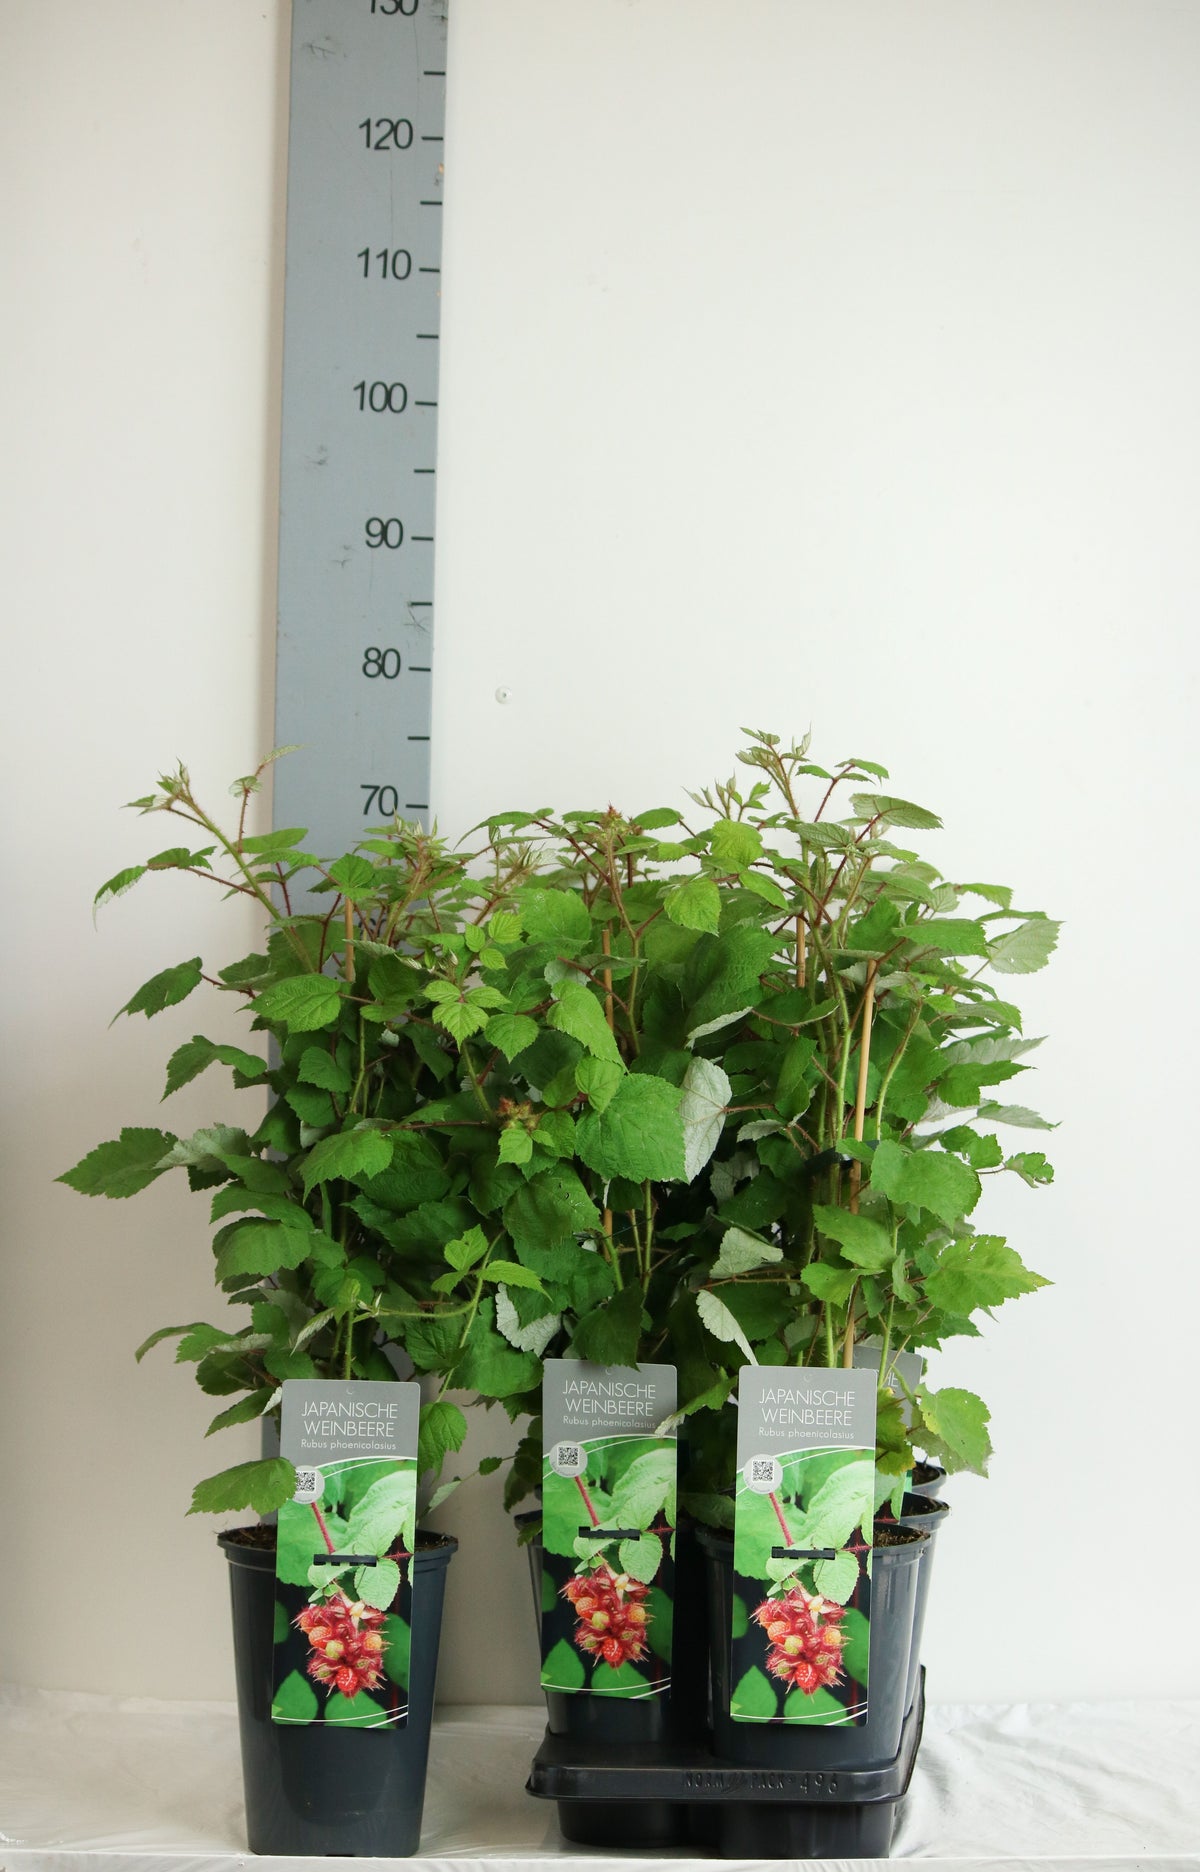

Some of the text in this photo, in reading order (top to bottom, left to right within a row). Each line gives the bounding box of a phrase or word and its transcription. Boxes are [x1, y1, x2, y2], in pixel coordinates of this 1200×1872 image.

[358, 118, 414, 150] 120
[357, 247, 412, 280] 110
[353, 380, 408, 413] 100
[364, 517, 404, 549] 90
[362, 647, 401, 679] 80
[360, 784, 398, 816] 70
[562, 1380, 656, 1399] JAPANISCHE
[759, 1388, 856, 1407] JAPANISCHE
[301, 1401, 399, 1419] JAPANISCHE
[565, 1398, 654, 1417] WEINBEERE
[761, 1407, 853, 1426] WEINBEERE
[304, 1420, 395, 1438] WEINBEERE
[563, 1416, 656, 1429] Rubus phoenicolasius
[758, 1427, 855, 1440] Rubus phoenicolasius
[300, 1439, 397, 1451] Rubus phoenicolasius
[799, 1772, 839, 1794] 496
